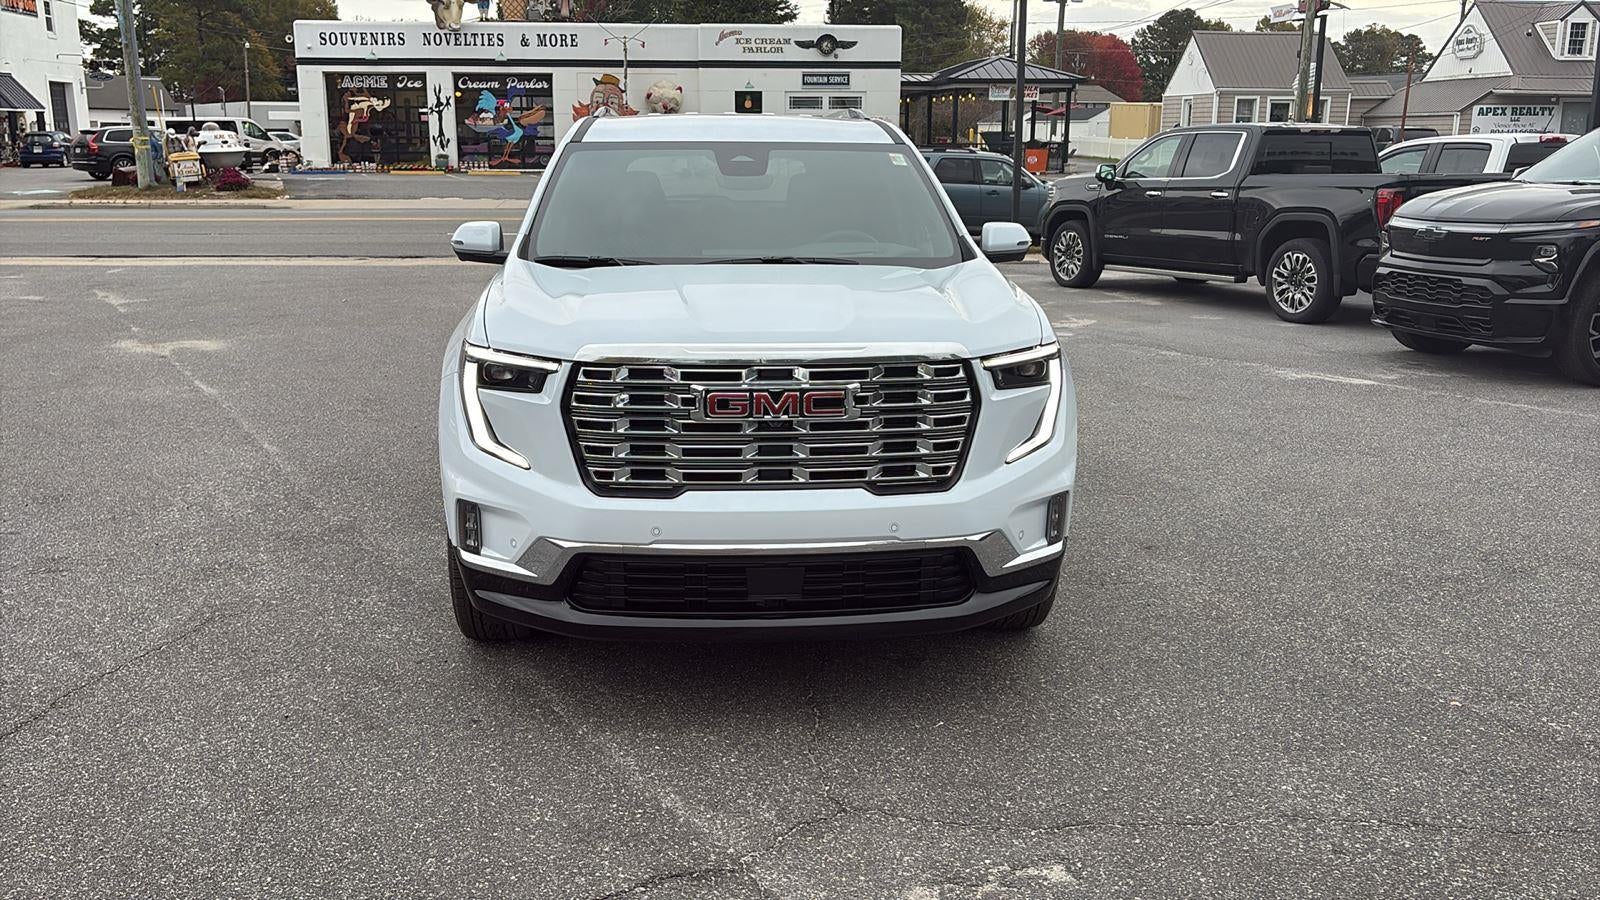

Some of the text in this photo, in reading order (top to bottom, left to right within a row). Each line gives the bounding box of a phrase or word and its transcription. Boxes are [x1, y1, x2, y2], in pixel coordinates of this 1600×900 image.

[319, 32, 578, 48] SOUVENIRS NOVELTIES & MORE
[754, 37, 791, 45] CREAM
[742, 46, 784, 54] PARLOR
[341, 75, 424, 88] ACME Ice
[457, 76, 550, 89] Cream Parlor
[804, 75, 849, 84] FOUNTAIN SERVICE
[1477, 106, 1555, 117] APEX REALTY
[707, 391, 845, 418] GMC
